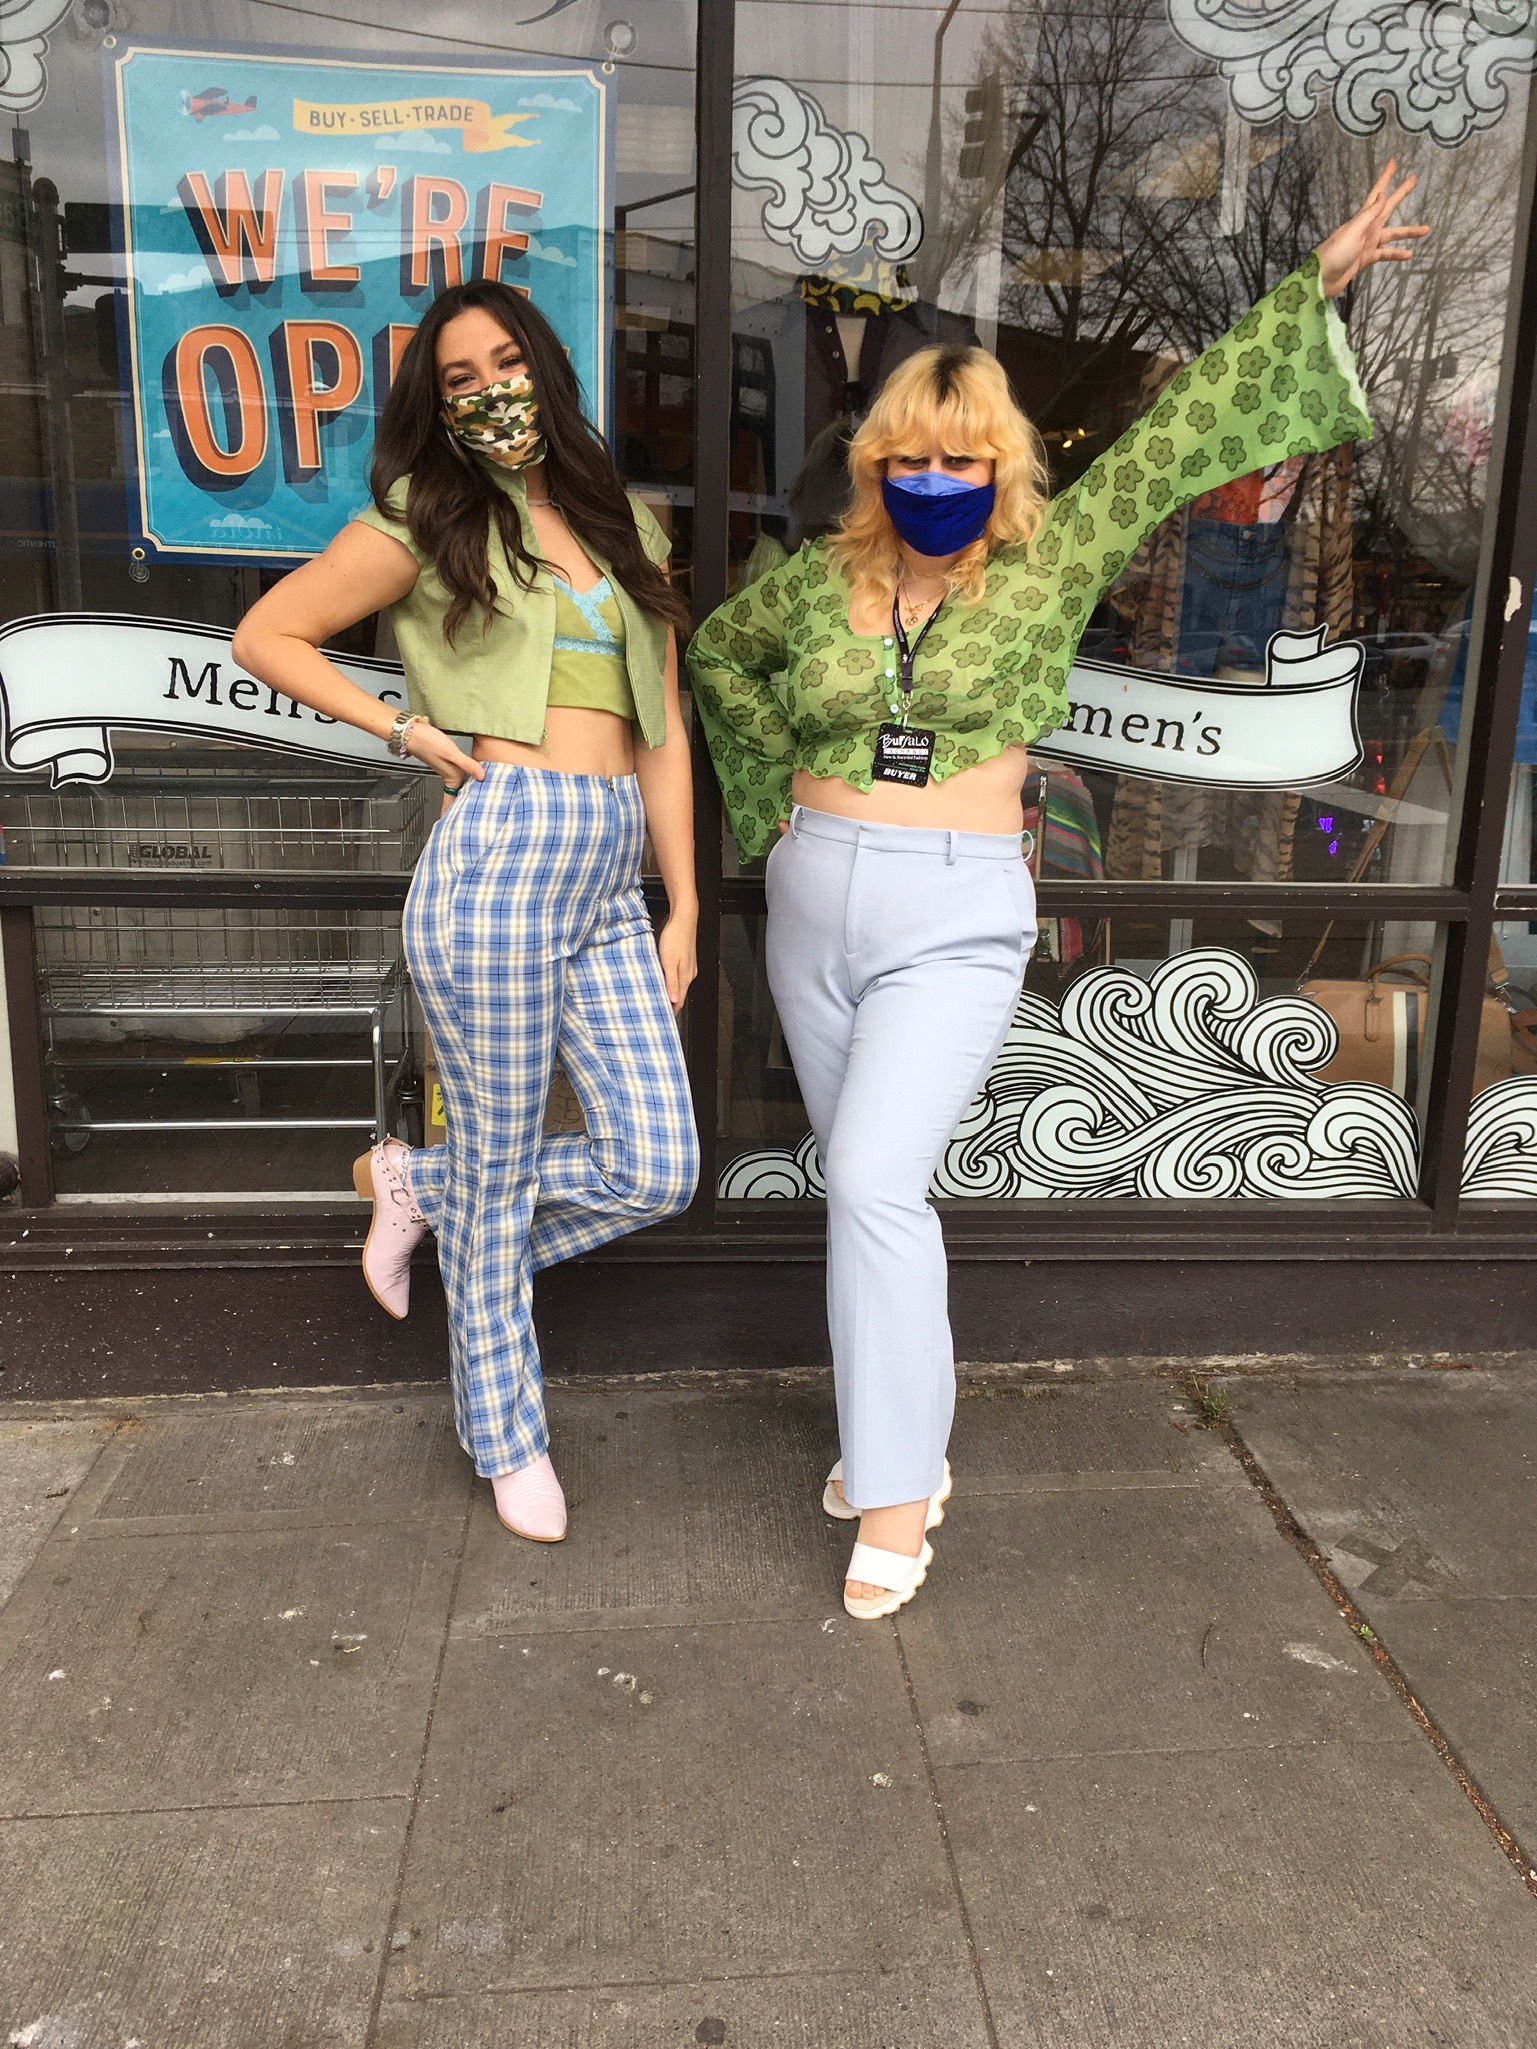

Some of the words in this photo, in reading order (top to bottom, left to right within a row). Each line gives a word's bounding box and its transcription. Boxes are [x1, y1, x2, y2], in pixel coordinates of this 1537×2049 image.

[309, 110, 346, 128] BUY
[359, 108, 404, 127] SELL
[412, 105, 474, 122] TRADE
[180, 165, 544, 301] WE'RE
[883, 768, 917, 781] BUYER
[140, 845, 213, 860] GLOBAL
